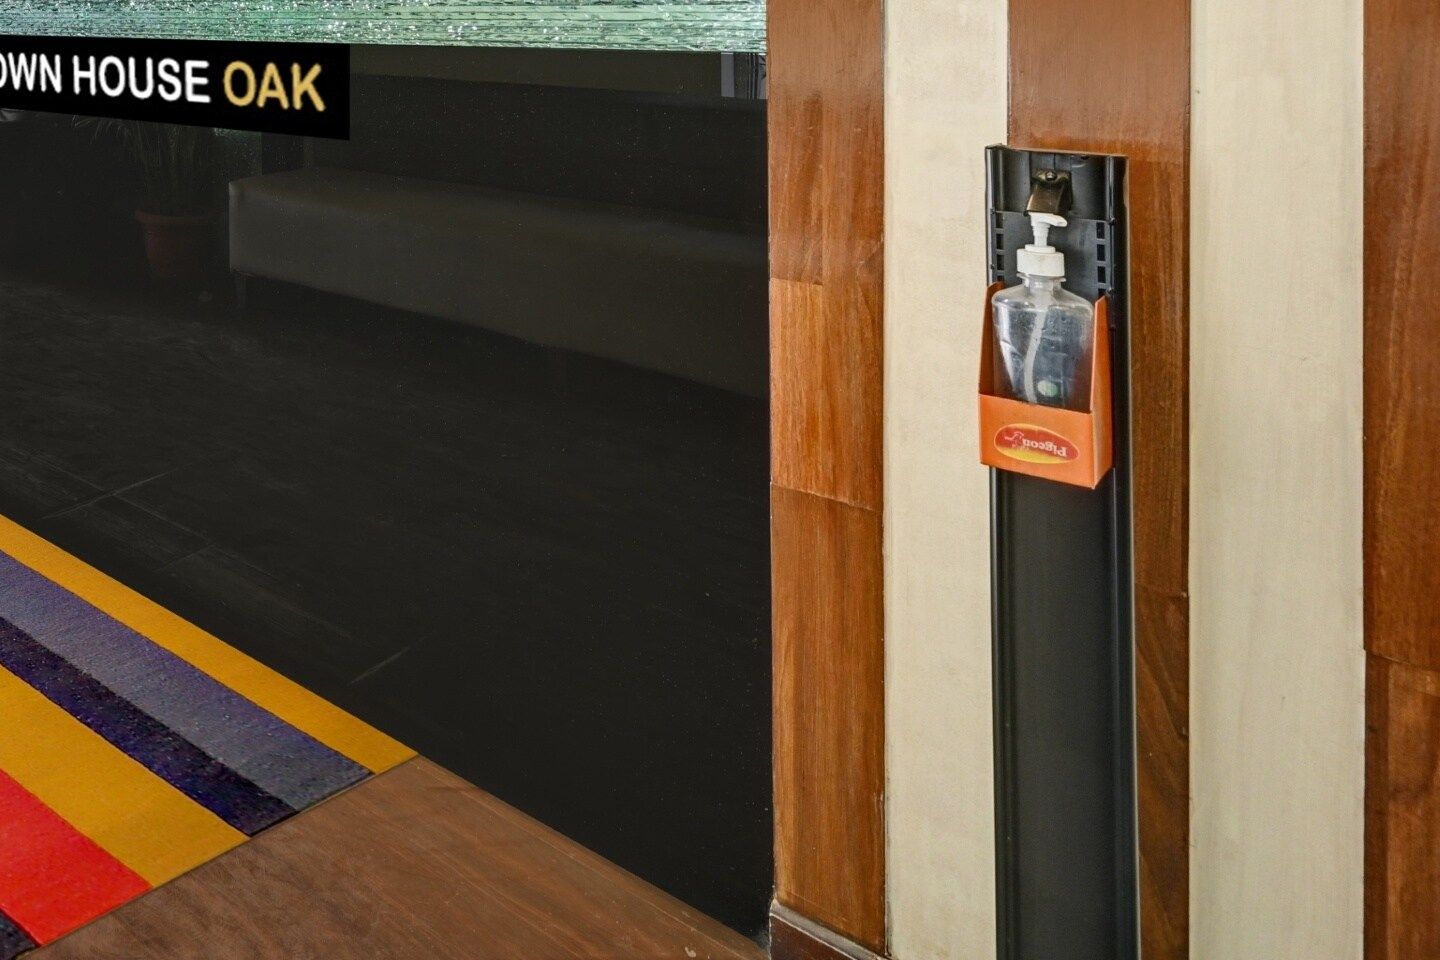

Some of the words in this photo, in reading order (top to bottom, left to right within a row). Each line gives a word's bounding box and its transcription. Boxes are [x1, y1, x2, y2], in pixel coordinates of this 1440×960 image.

[72, 55, 212, 103] HOUSE
[223, 60, 327, 113] OAK
[1022, 437, 1068, 458] Pigeon
